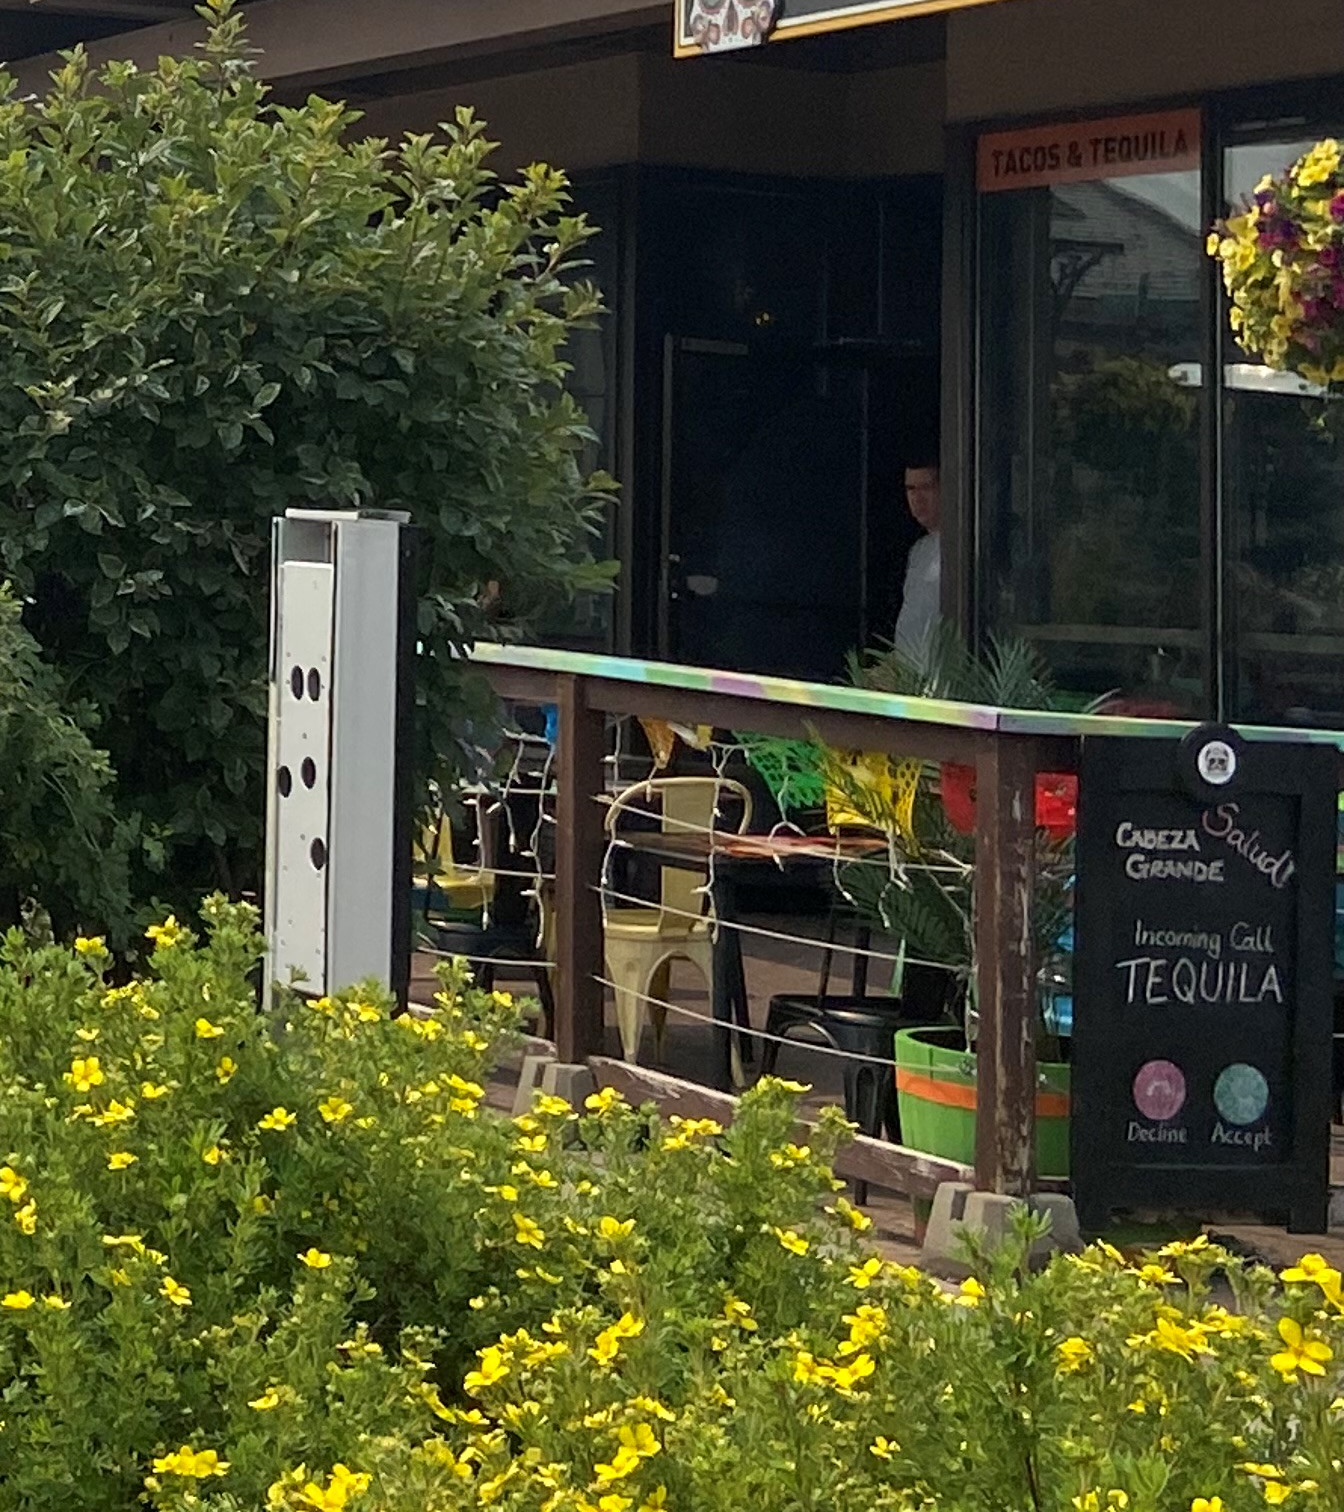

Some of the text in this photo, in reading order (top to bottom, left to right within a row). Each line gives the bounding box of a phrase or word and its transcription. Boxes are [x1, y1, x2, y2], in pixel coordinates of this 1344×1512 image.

[991, 128, 1189, 177] TACOS & TEQUILA
[1116, 822, 1200, 852] CABEZA
[1125, 853, 1224, 882] GRANDE
[1135, 919, 1274, 960] Incoming Call
[1115, 957, 1283, 1004] TEQUILA
[1127, 1121, 1272, 1152] Decline Accept
